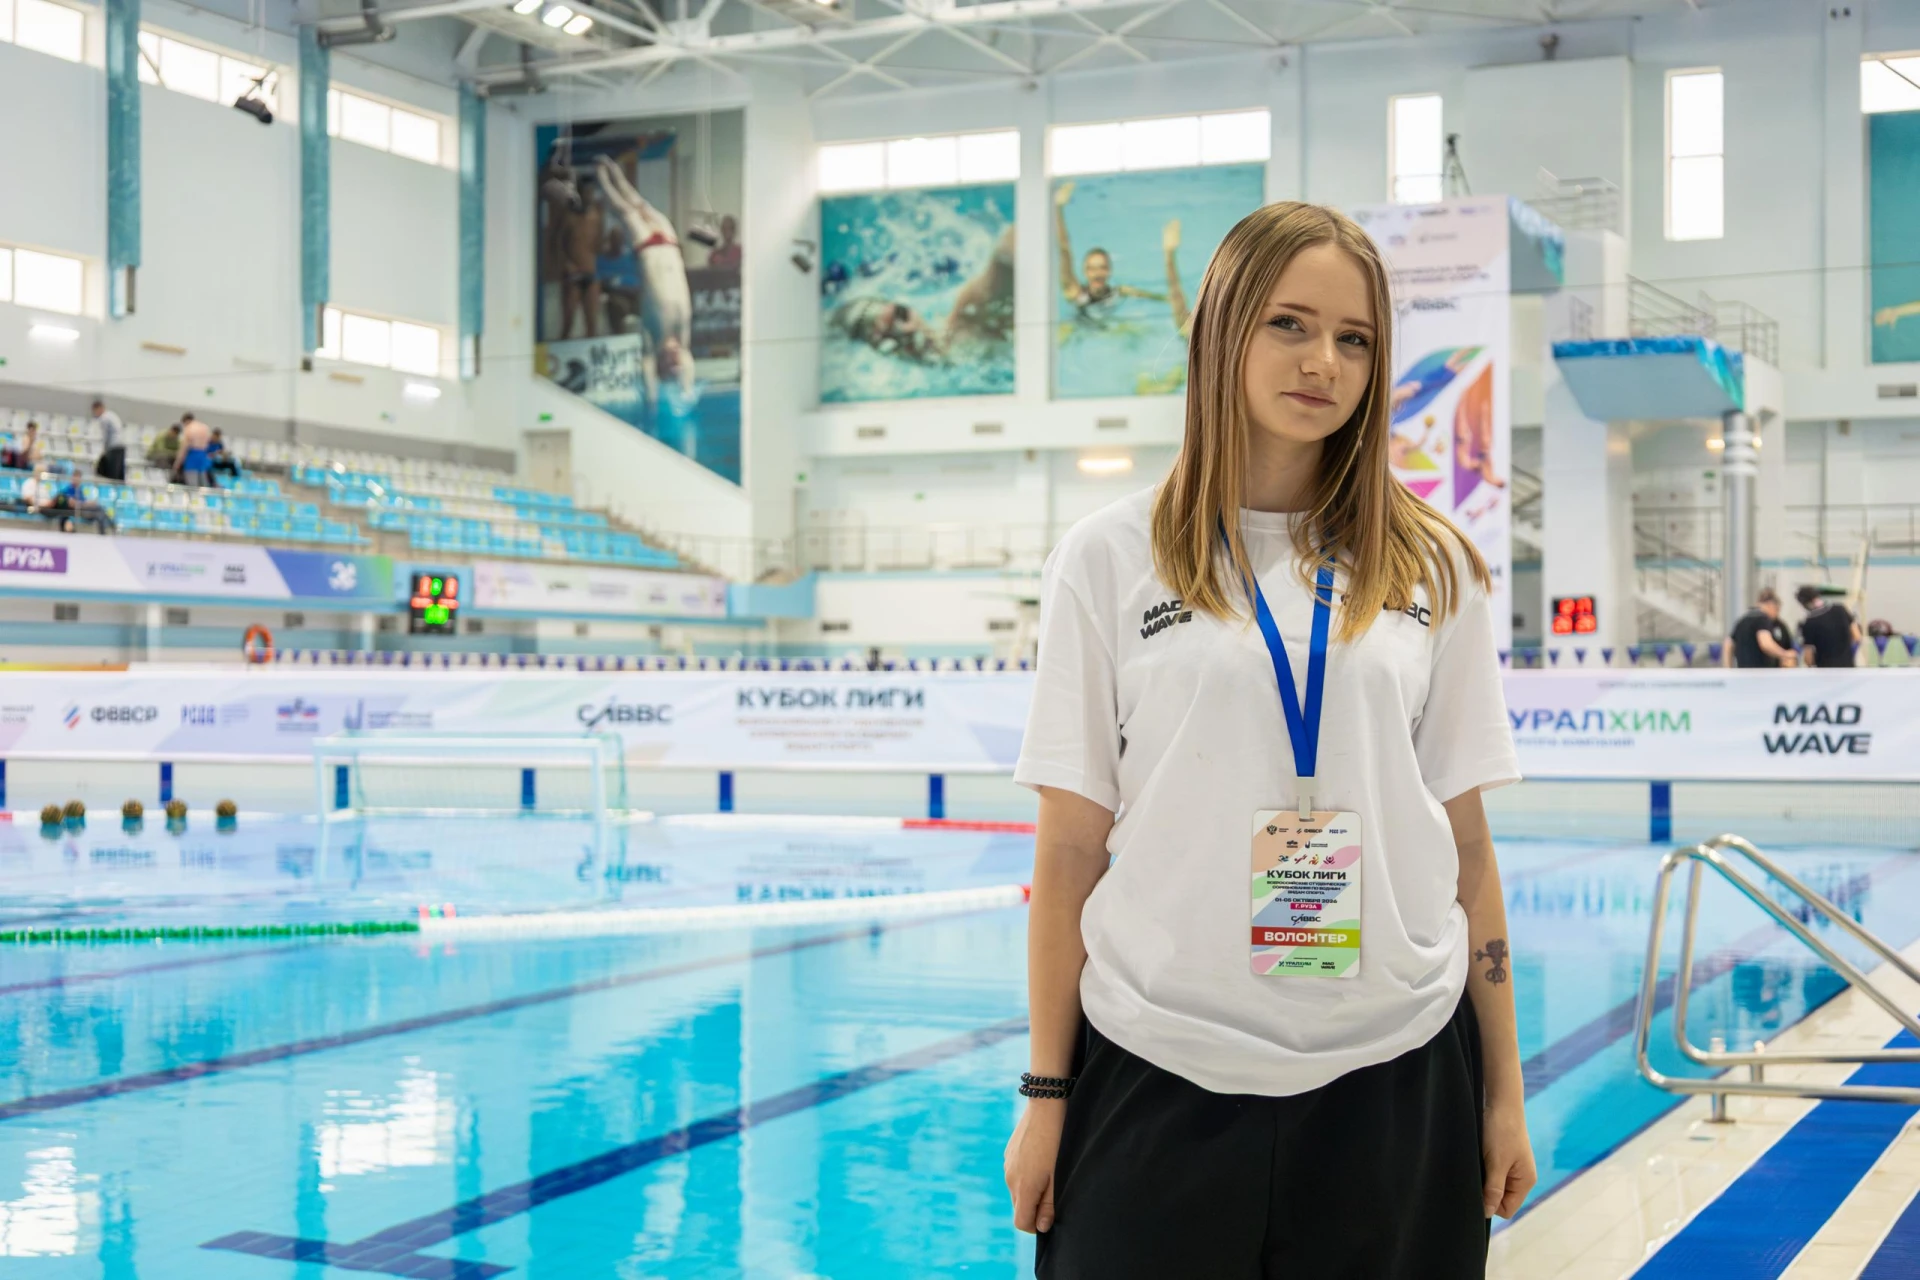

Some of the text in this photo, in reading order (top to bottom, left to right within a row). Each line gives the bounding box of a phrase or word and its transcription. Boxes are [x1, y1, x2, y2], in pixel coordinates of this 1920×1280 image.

[3, 546, 55, 570] РУЗА
[1143, 600, 1183, 625] MAD
[1140, 610, 1193, 639] WAVE
[737, 687, 925, 708] КУБОК ЛИГИ
[90, 704, 158, 723] ФВВСР
[1509, 709, 1692, 732] УРАЛХИМ
[1773, 703, 1862, 725] MAD
[1762, 732, 1872, 754] WAVE
[1267, 870, 1346, 880] КУБОК ЛИГИ
[1264, 931, 1348, 943] ВОЛОНТЕР
